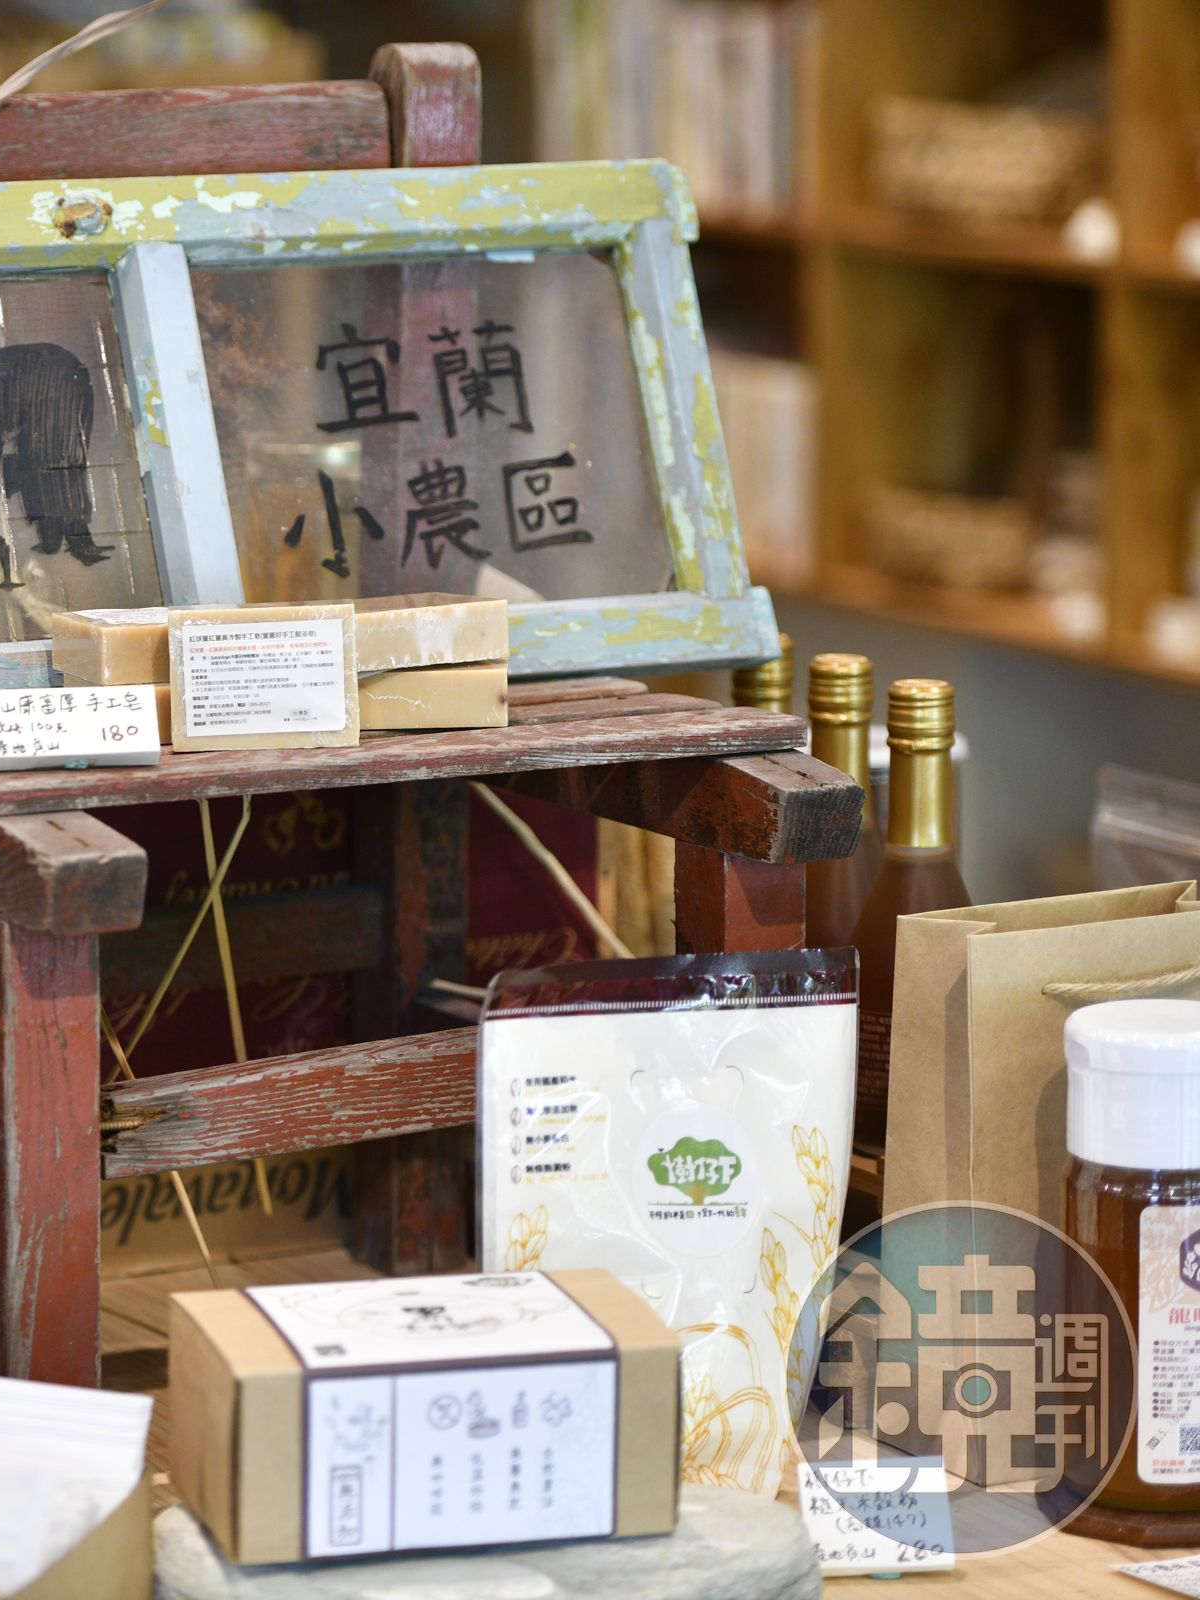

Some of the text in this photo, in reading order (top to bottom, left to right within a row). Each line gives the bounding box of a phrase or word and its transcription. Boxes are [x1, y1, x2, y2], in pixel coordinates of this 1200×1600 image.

[316, 319, 534, 438] 宜蘭
[285, 452, 594, 578] 小農區
[87, 692, 143, 712] 手工皂
[102, 725, 139, 741] 180
[897, 1539, 945, 1563] 280
